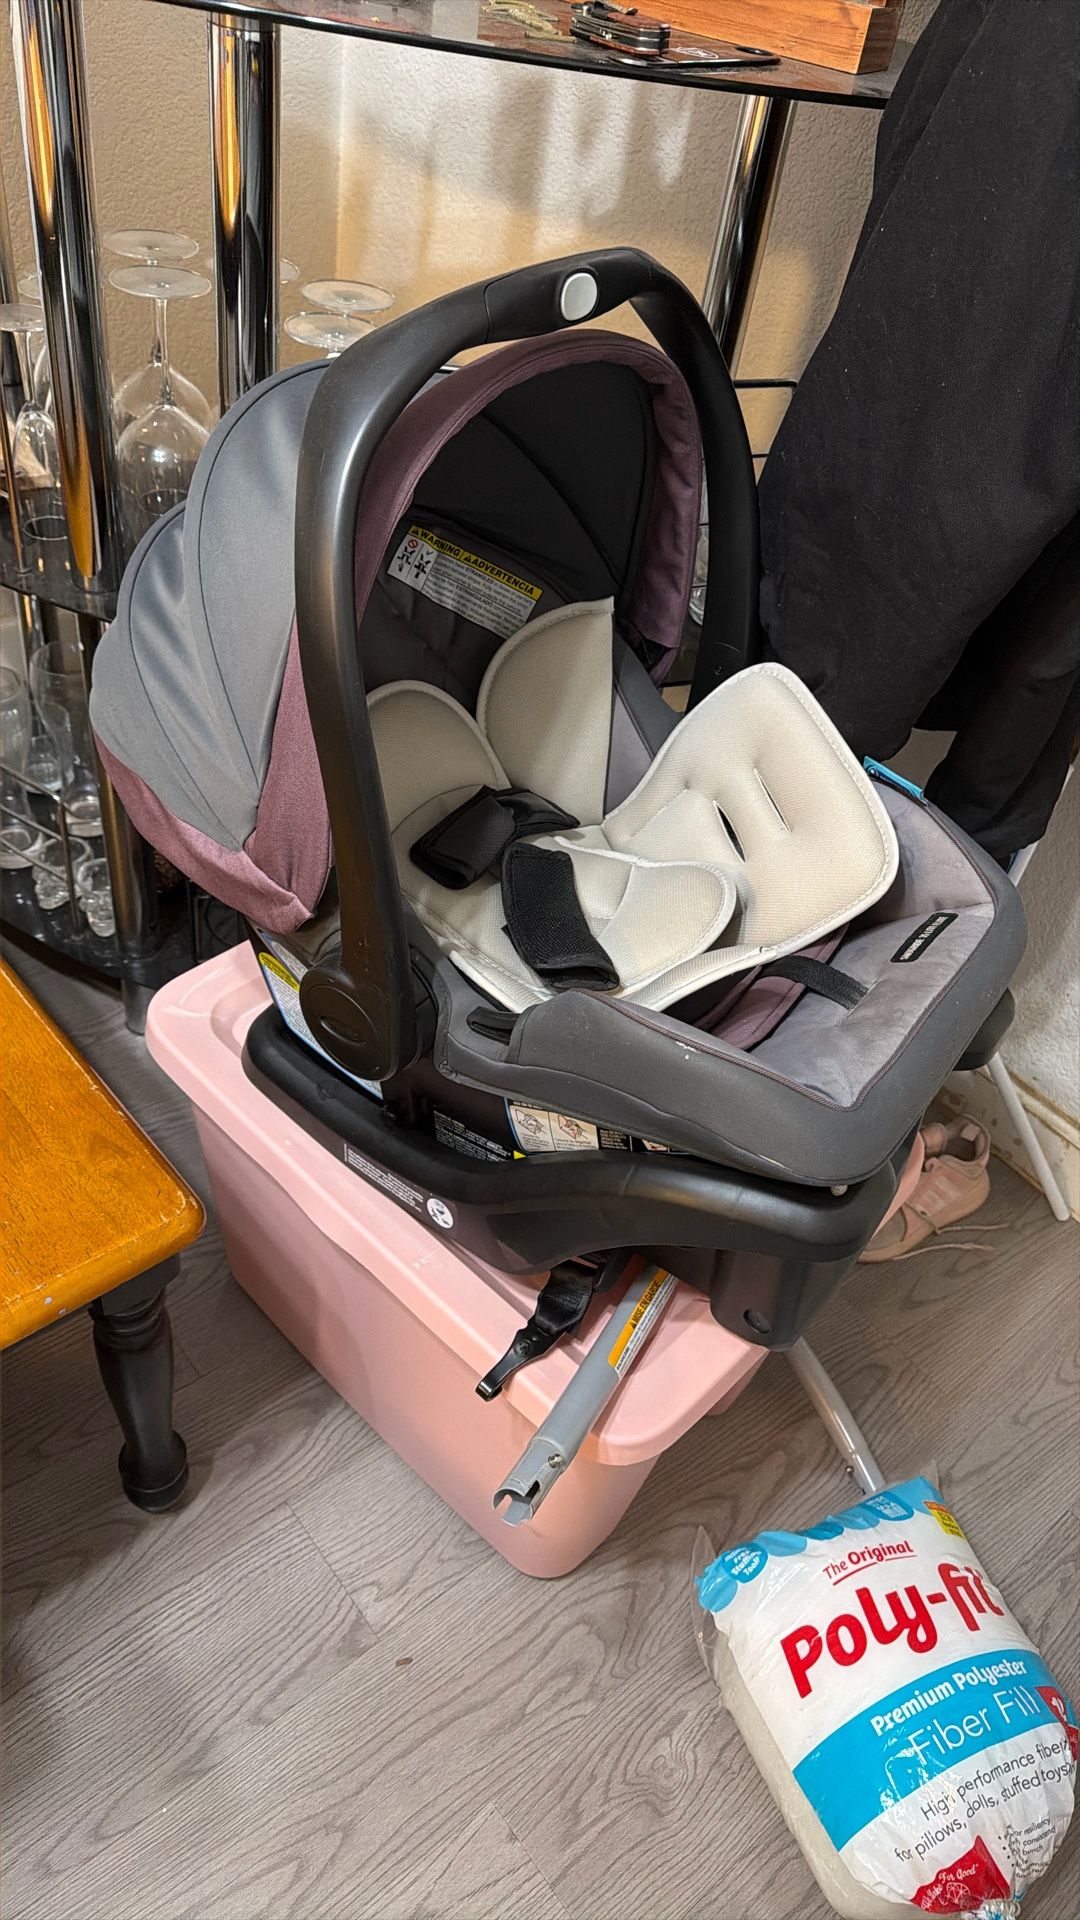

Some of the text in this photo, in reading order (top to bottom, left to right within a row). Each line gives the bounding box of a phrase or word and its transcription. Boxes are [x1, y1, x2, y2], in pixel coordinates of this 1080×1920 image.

[420, 530, 461, 557] WARNING
[471, 558, 535, 596] ADVERTENCIA
[823, 1540, 914, 1580] The Original
[870, 1659, 1028, 1737] Premium Polyester
[907, 1685, 1041, 1766] Fiber Fill
[894, 1848, 914, 1863] for
[914, 1818, 967, 1861] pillows,
[966, 1794, 1000, 1819] dolls,
[1000, 1770, 1042, 1803] stuffed
[920, 1791, 956, 1821] High
[956, 1753, 1036, 1802] performance
